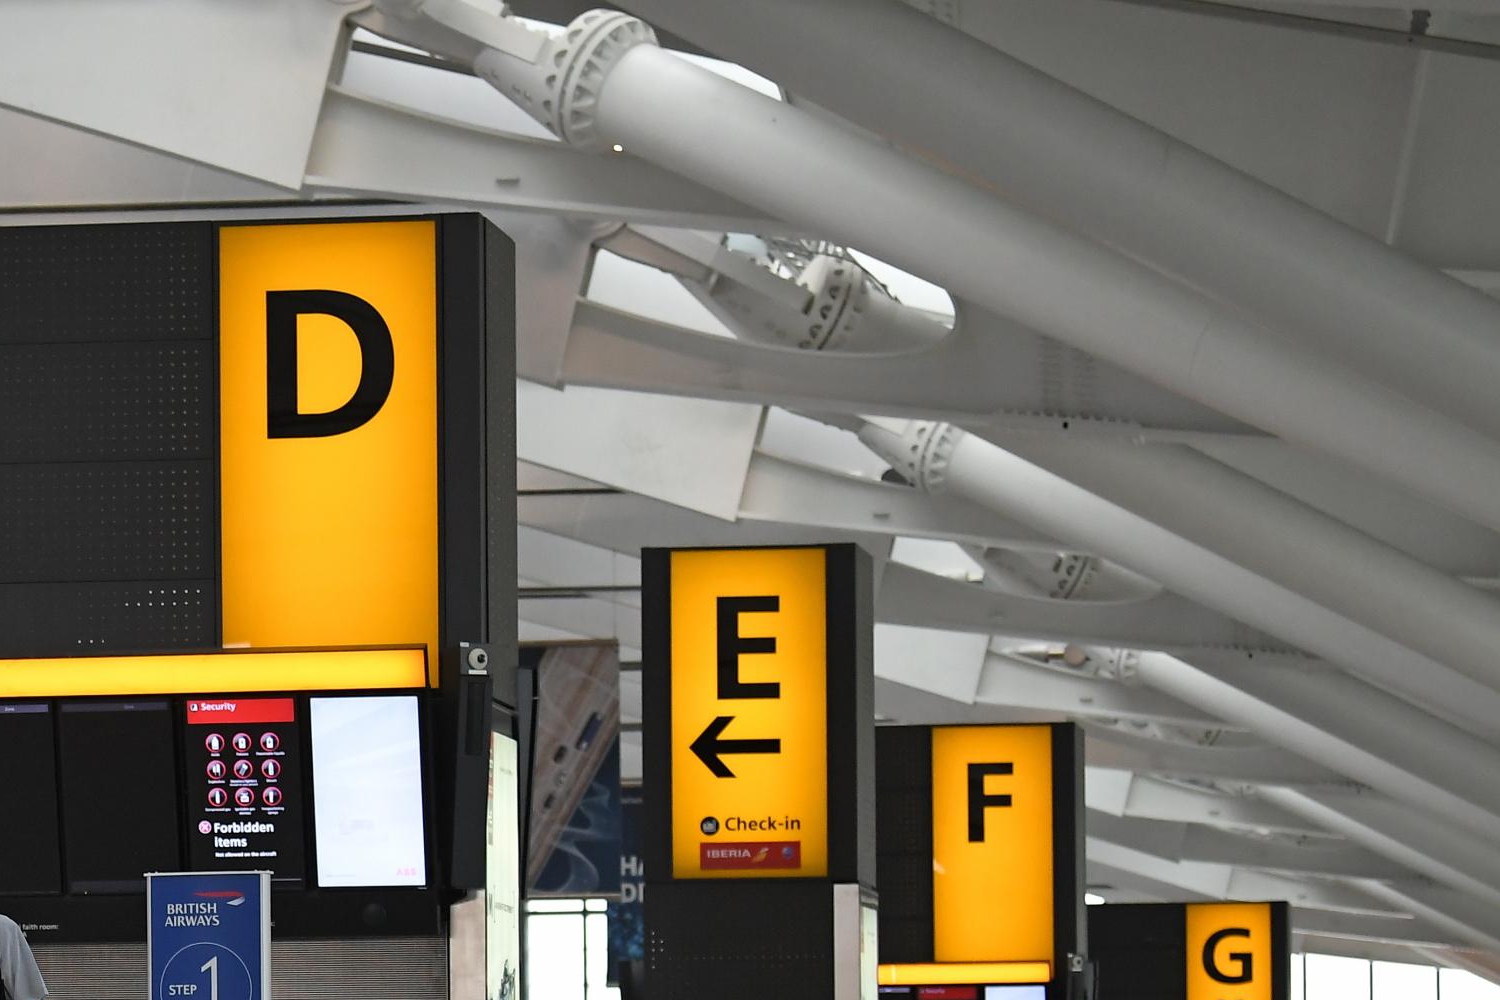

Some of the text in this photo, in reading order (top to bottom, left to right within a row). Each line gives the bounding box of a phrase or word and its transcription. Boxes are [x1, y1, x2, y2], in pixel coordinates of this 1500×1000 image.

[265, 289, 395, 439] D
[716, 596, 780, 700] E
[200, 701, 236, 713] Security
[967, 762, 1013, 843] F
[213, 821, 274, 834] Forbidden
[725, 816, 801, 831] Check-in
[707, 849, 751, 858] IBERIA
[167, 903, 217, 915] BRITISH
[165, 915, 220, 927] AIRWAYS
[1202, 928, 1253, 984] G
[168, 985, 197, 996] STEP
